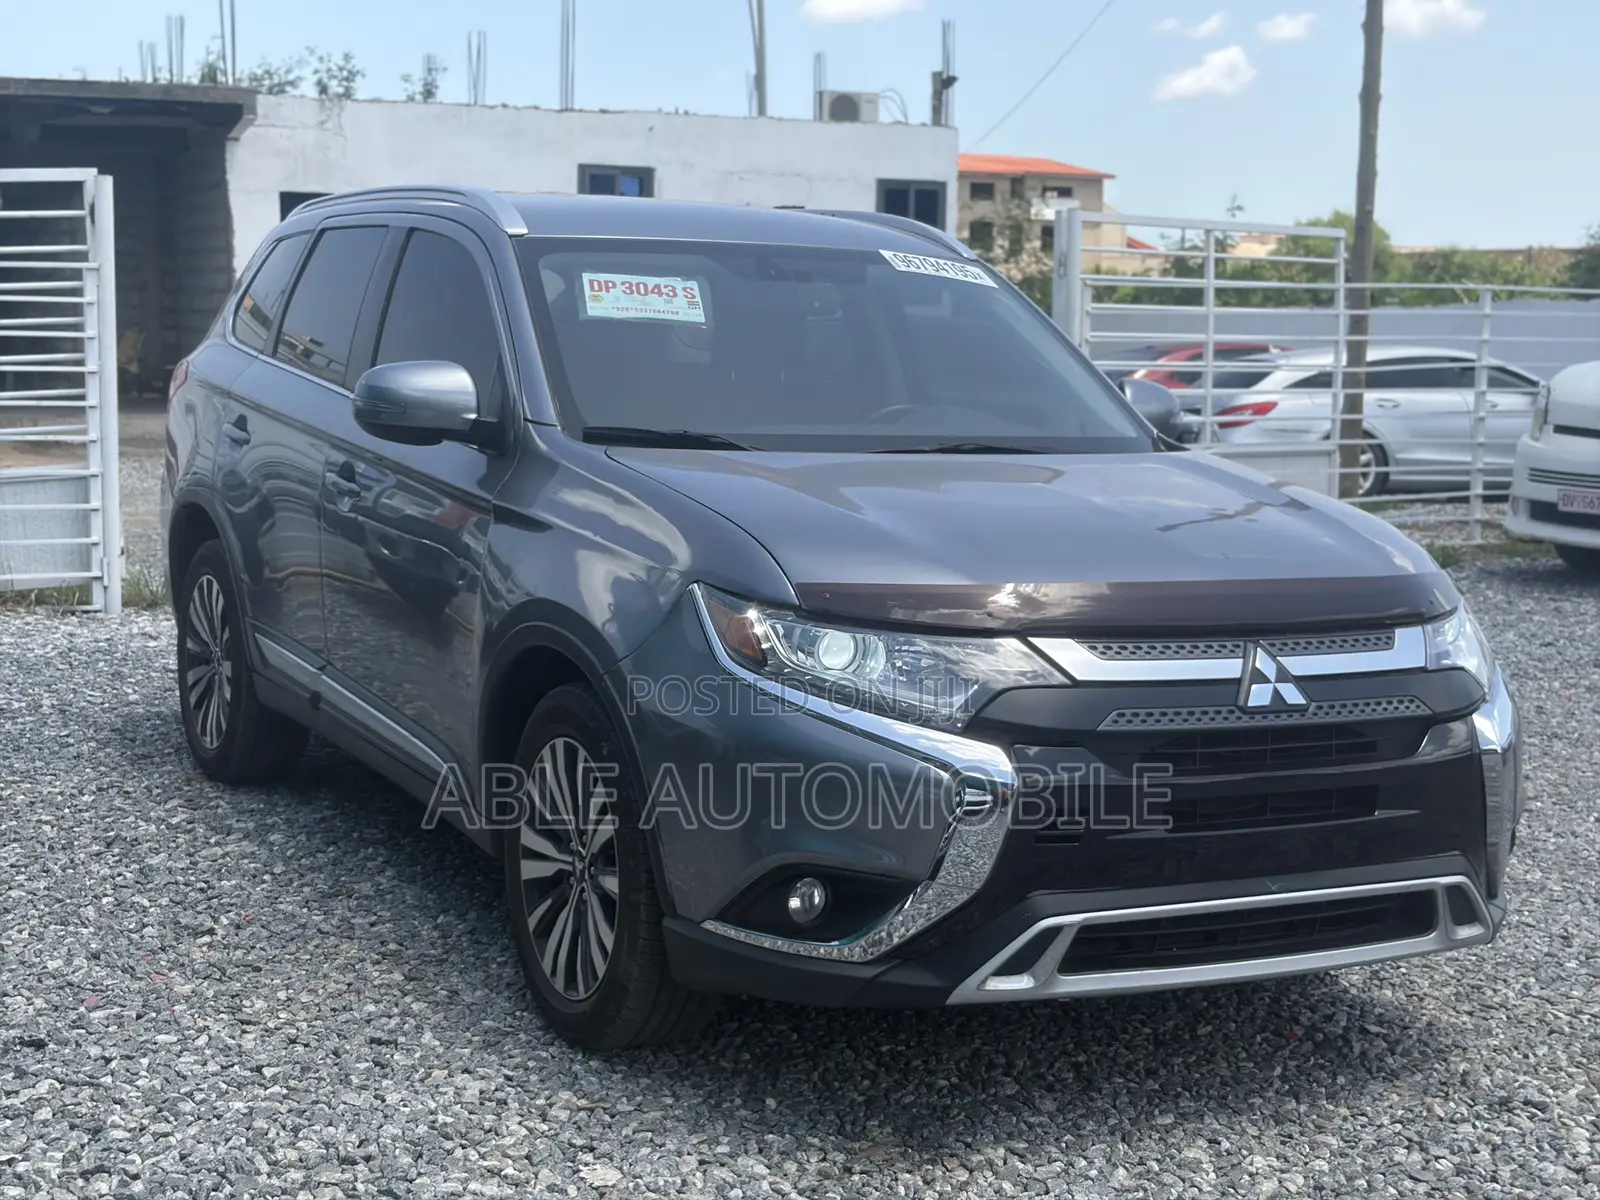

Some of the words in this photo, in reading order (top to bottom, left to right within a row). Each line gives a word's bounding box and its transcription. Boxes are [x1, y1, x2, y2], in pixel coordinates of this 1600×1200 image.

[588, 279, 617, 293] DP
[620, 281, 678, 299] 3043
[682, 286, 697, 300] S
